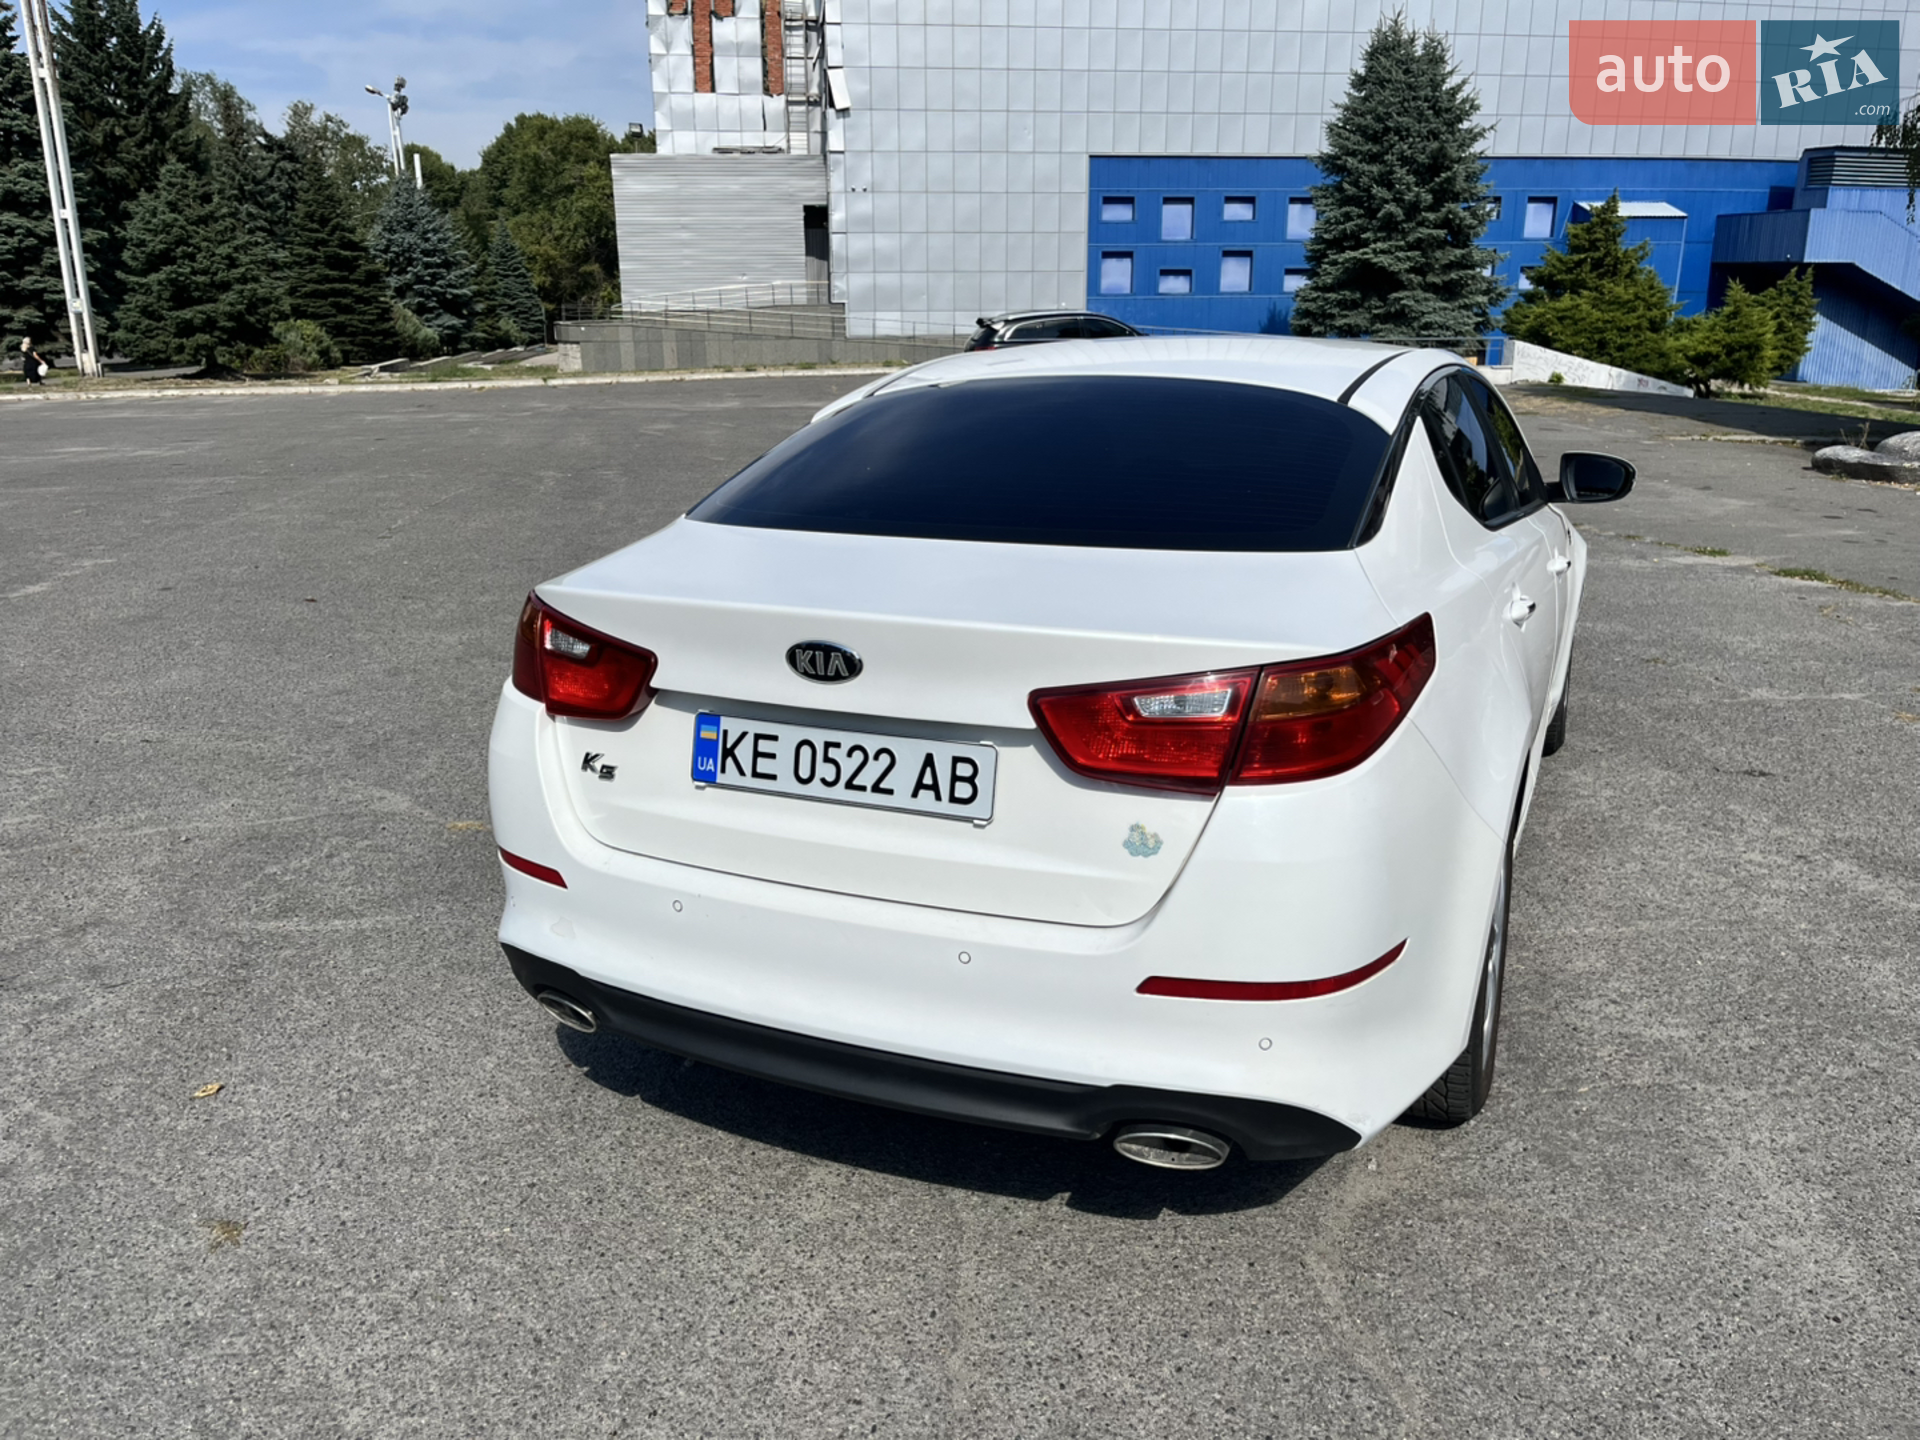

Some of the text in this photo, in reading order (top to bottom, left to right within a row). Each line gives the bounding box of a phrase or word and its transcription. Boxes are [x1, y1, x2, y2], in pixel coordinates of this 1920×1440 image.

[795, 649, 849, 676] KIA
[697, 756, 715, 773] UA
[720, 729, 979, 806] KE 0522 AB
